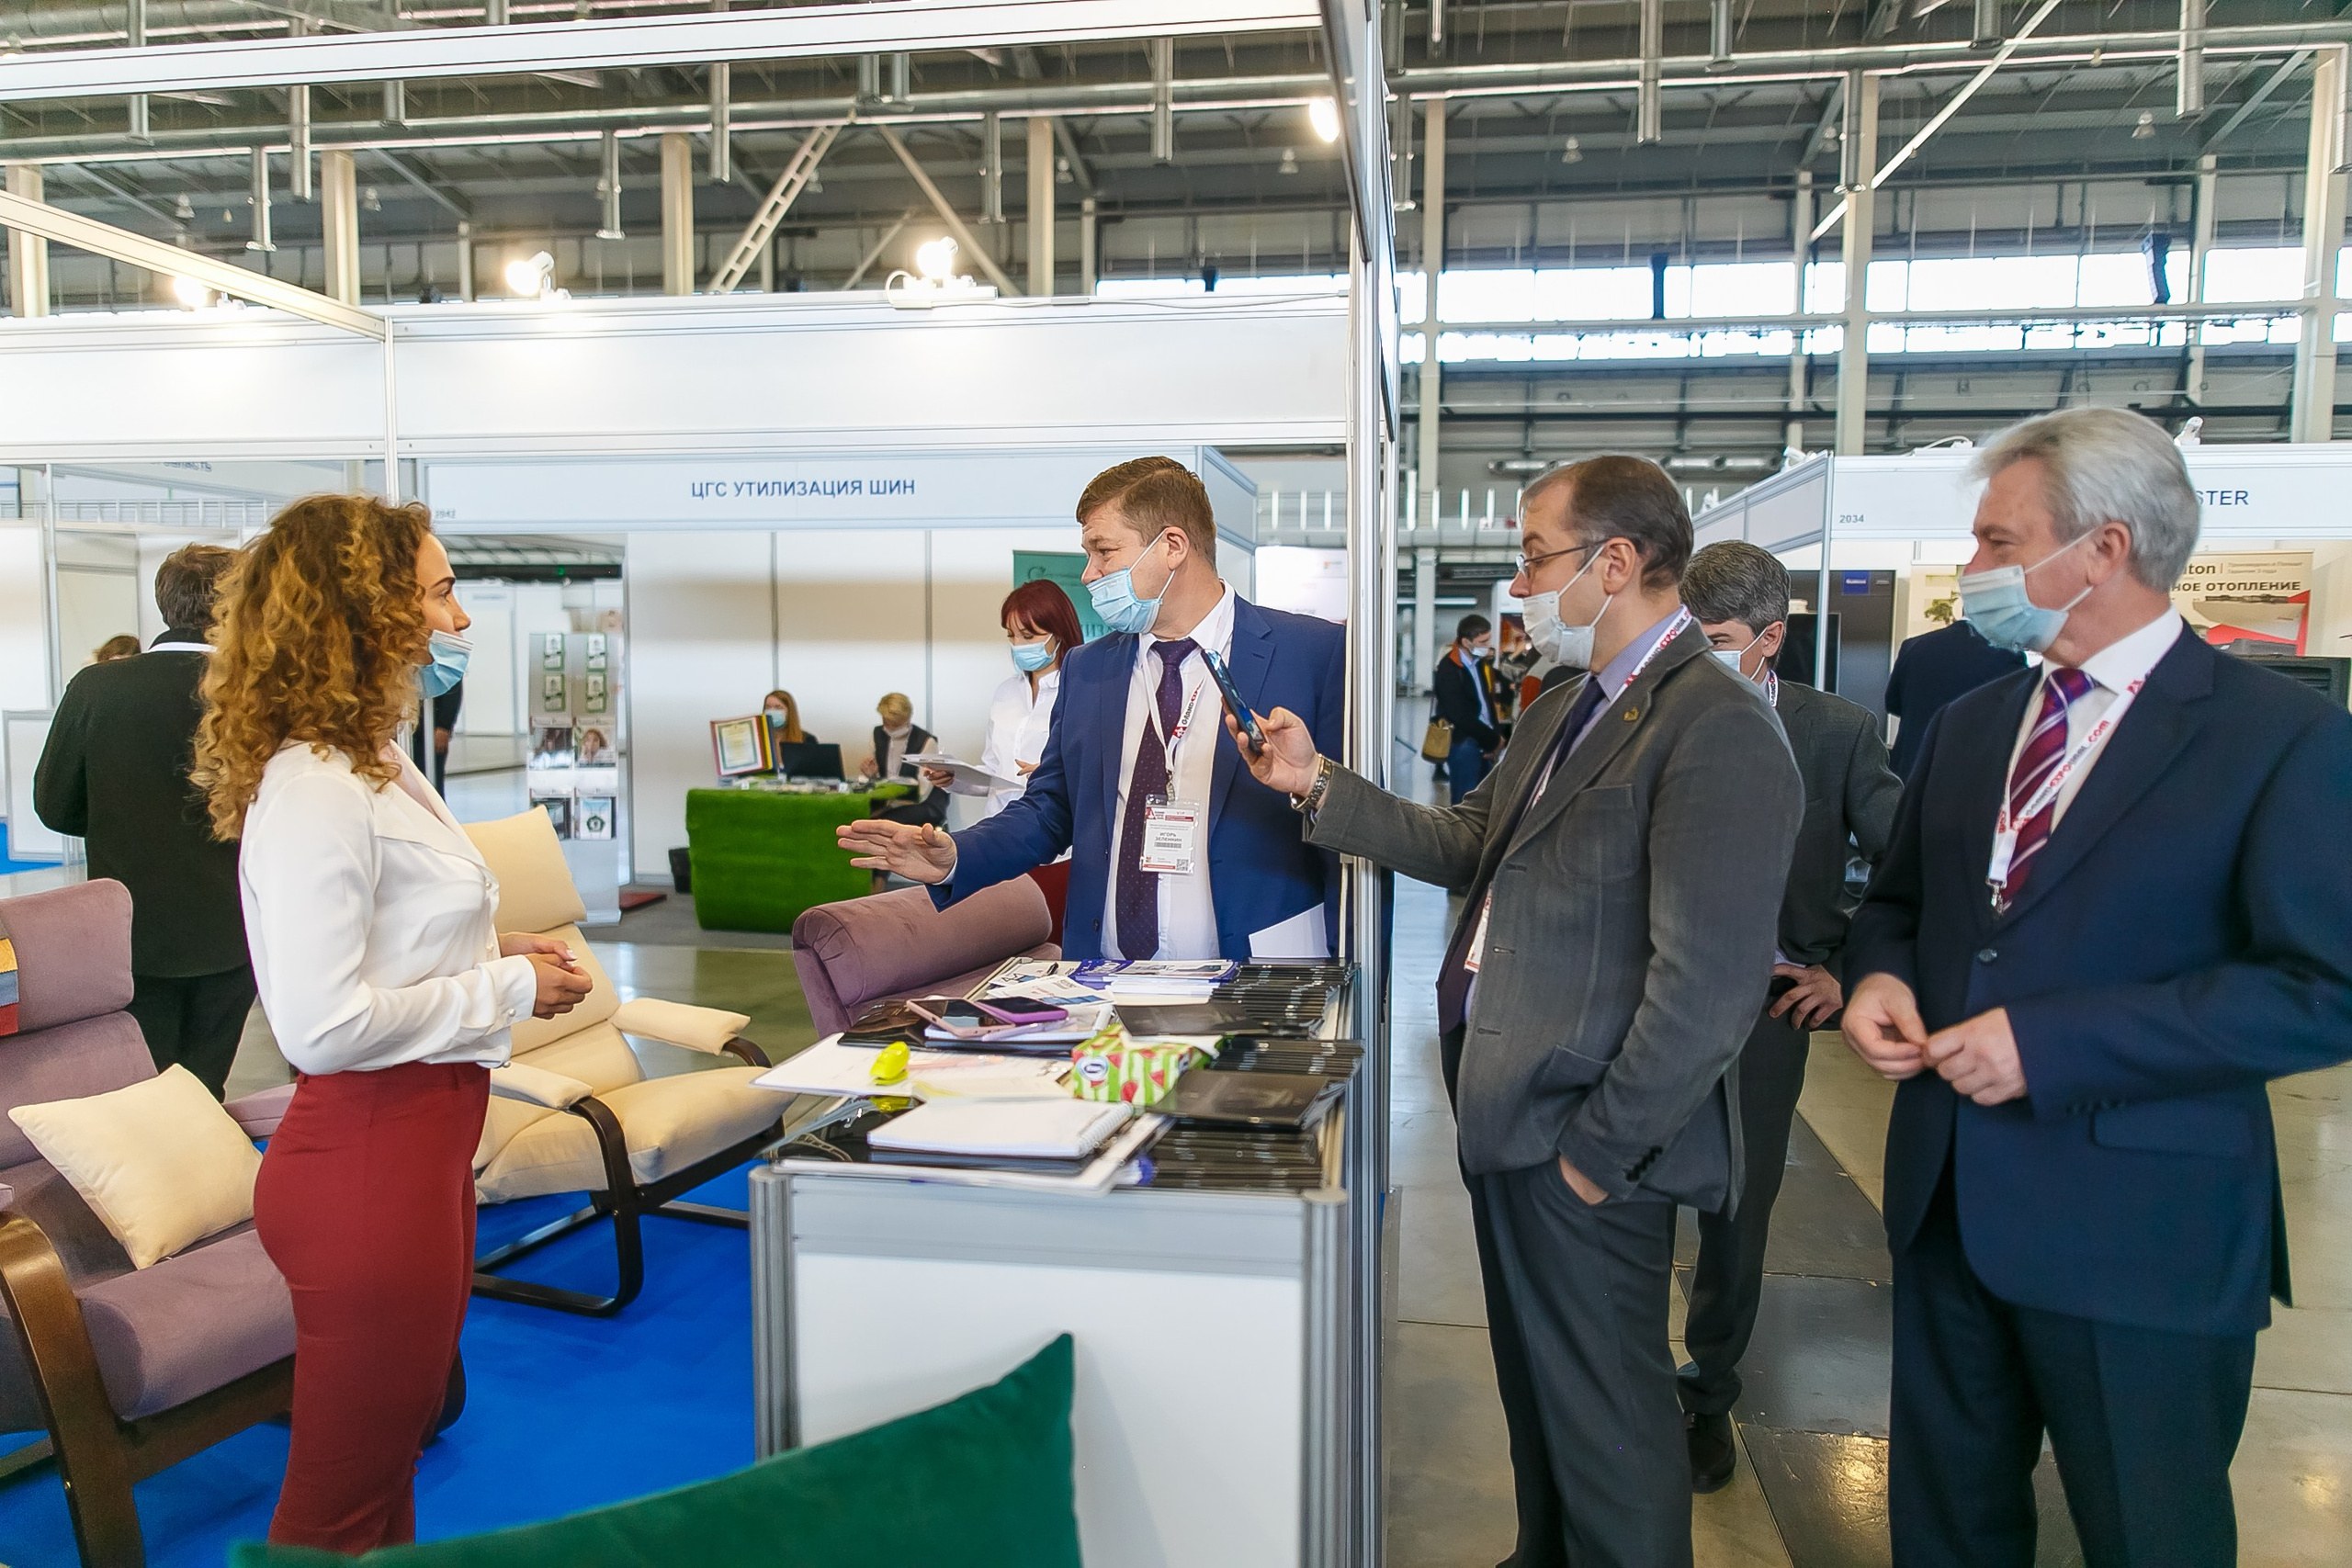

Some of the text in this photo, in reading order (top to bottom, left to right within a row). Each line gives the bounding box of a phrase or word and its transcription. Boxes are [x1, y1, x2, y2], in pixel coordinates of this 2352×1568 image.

[691, 479, 916, 500] ЦГС УТИЛИЗАЦИЯ ШИН
[1839, 514, 1865, 524] 2034
[2184, 563, 2216, 575] ton
[2205, 581, 2301, 592] ОТОПЛЕНИЕ
